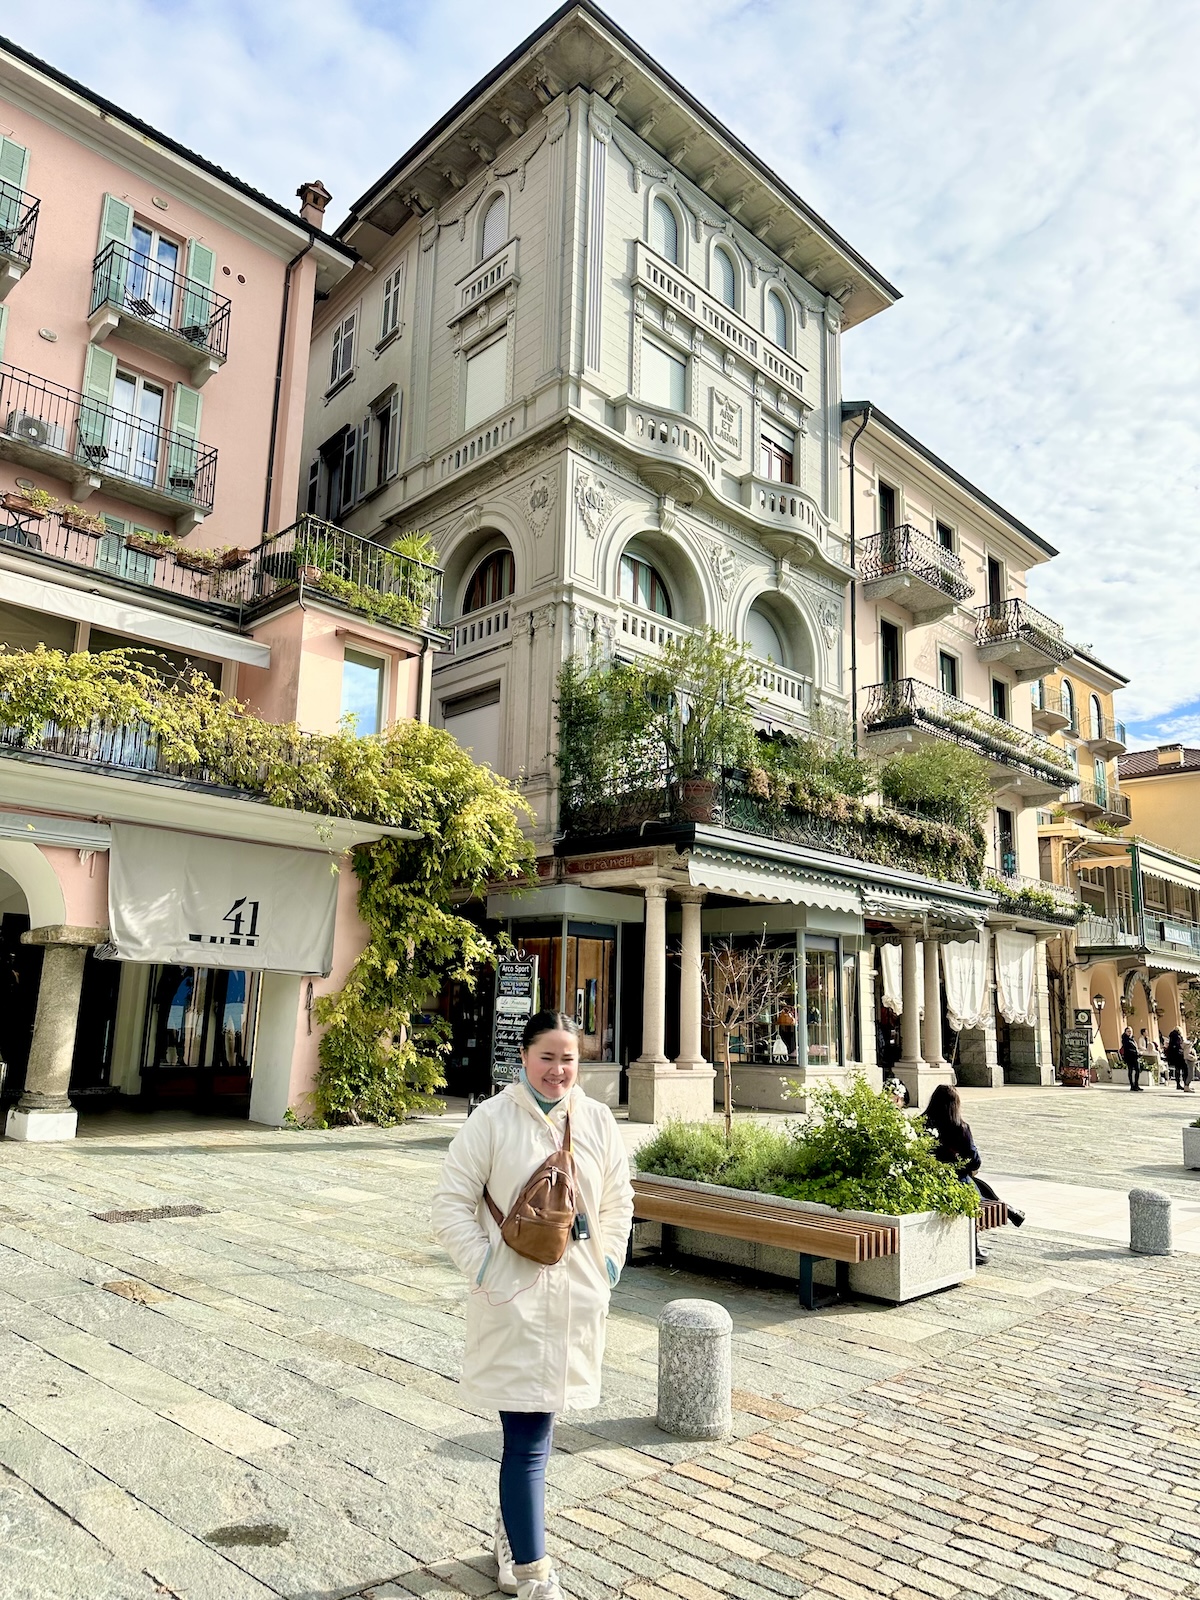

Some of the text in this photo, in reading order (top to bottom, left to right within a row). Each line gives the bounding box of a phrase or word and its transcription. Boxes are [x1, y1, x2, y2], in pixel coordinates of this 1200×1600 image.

[719, 409, 734, 423] ARS
[721, 420, 733, 433] ET
[714, 425, 739, 448] LABOR
[222, 896, 260, 937] 41
[501, 964, 530, 974] Arco Sport
[494, 1064, 508, 1074] Arco
